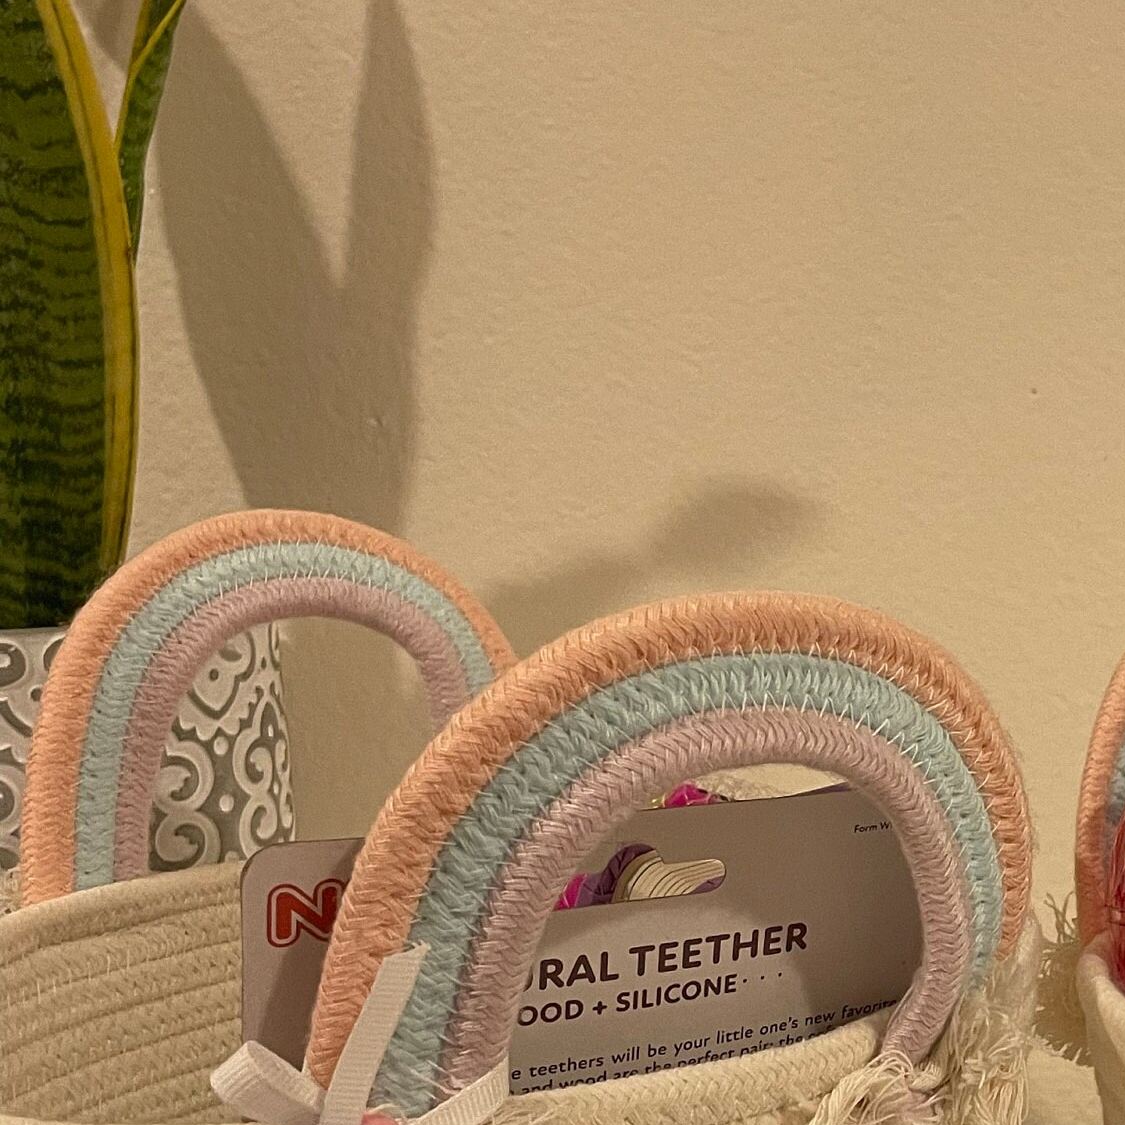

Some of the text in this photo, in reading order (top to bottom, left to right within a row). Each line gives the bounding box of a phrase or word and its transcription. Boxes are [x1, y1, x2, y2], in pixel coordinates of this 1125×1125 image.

[267, 879, 344, 948] N
[522, 922, 808, 992] RAL TEETHER
[592, 1001, 608, 1016] +
[616, 974, 737, 1012] SILICONE
[529, 1056, 604, 1078] teethers
[611, 1046, 640, 1064] will
[648, 1044, 667, 1058] be
[673, 1037, 711, 1057] your
[716, 1026, 753, 1045] little
[760, 1016, 799, 1036] one's
[805, 1011, 836, 1027] new
